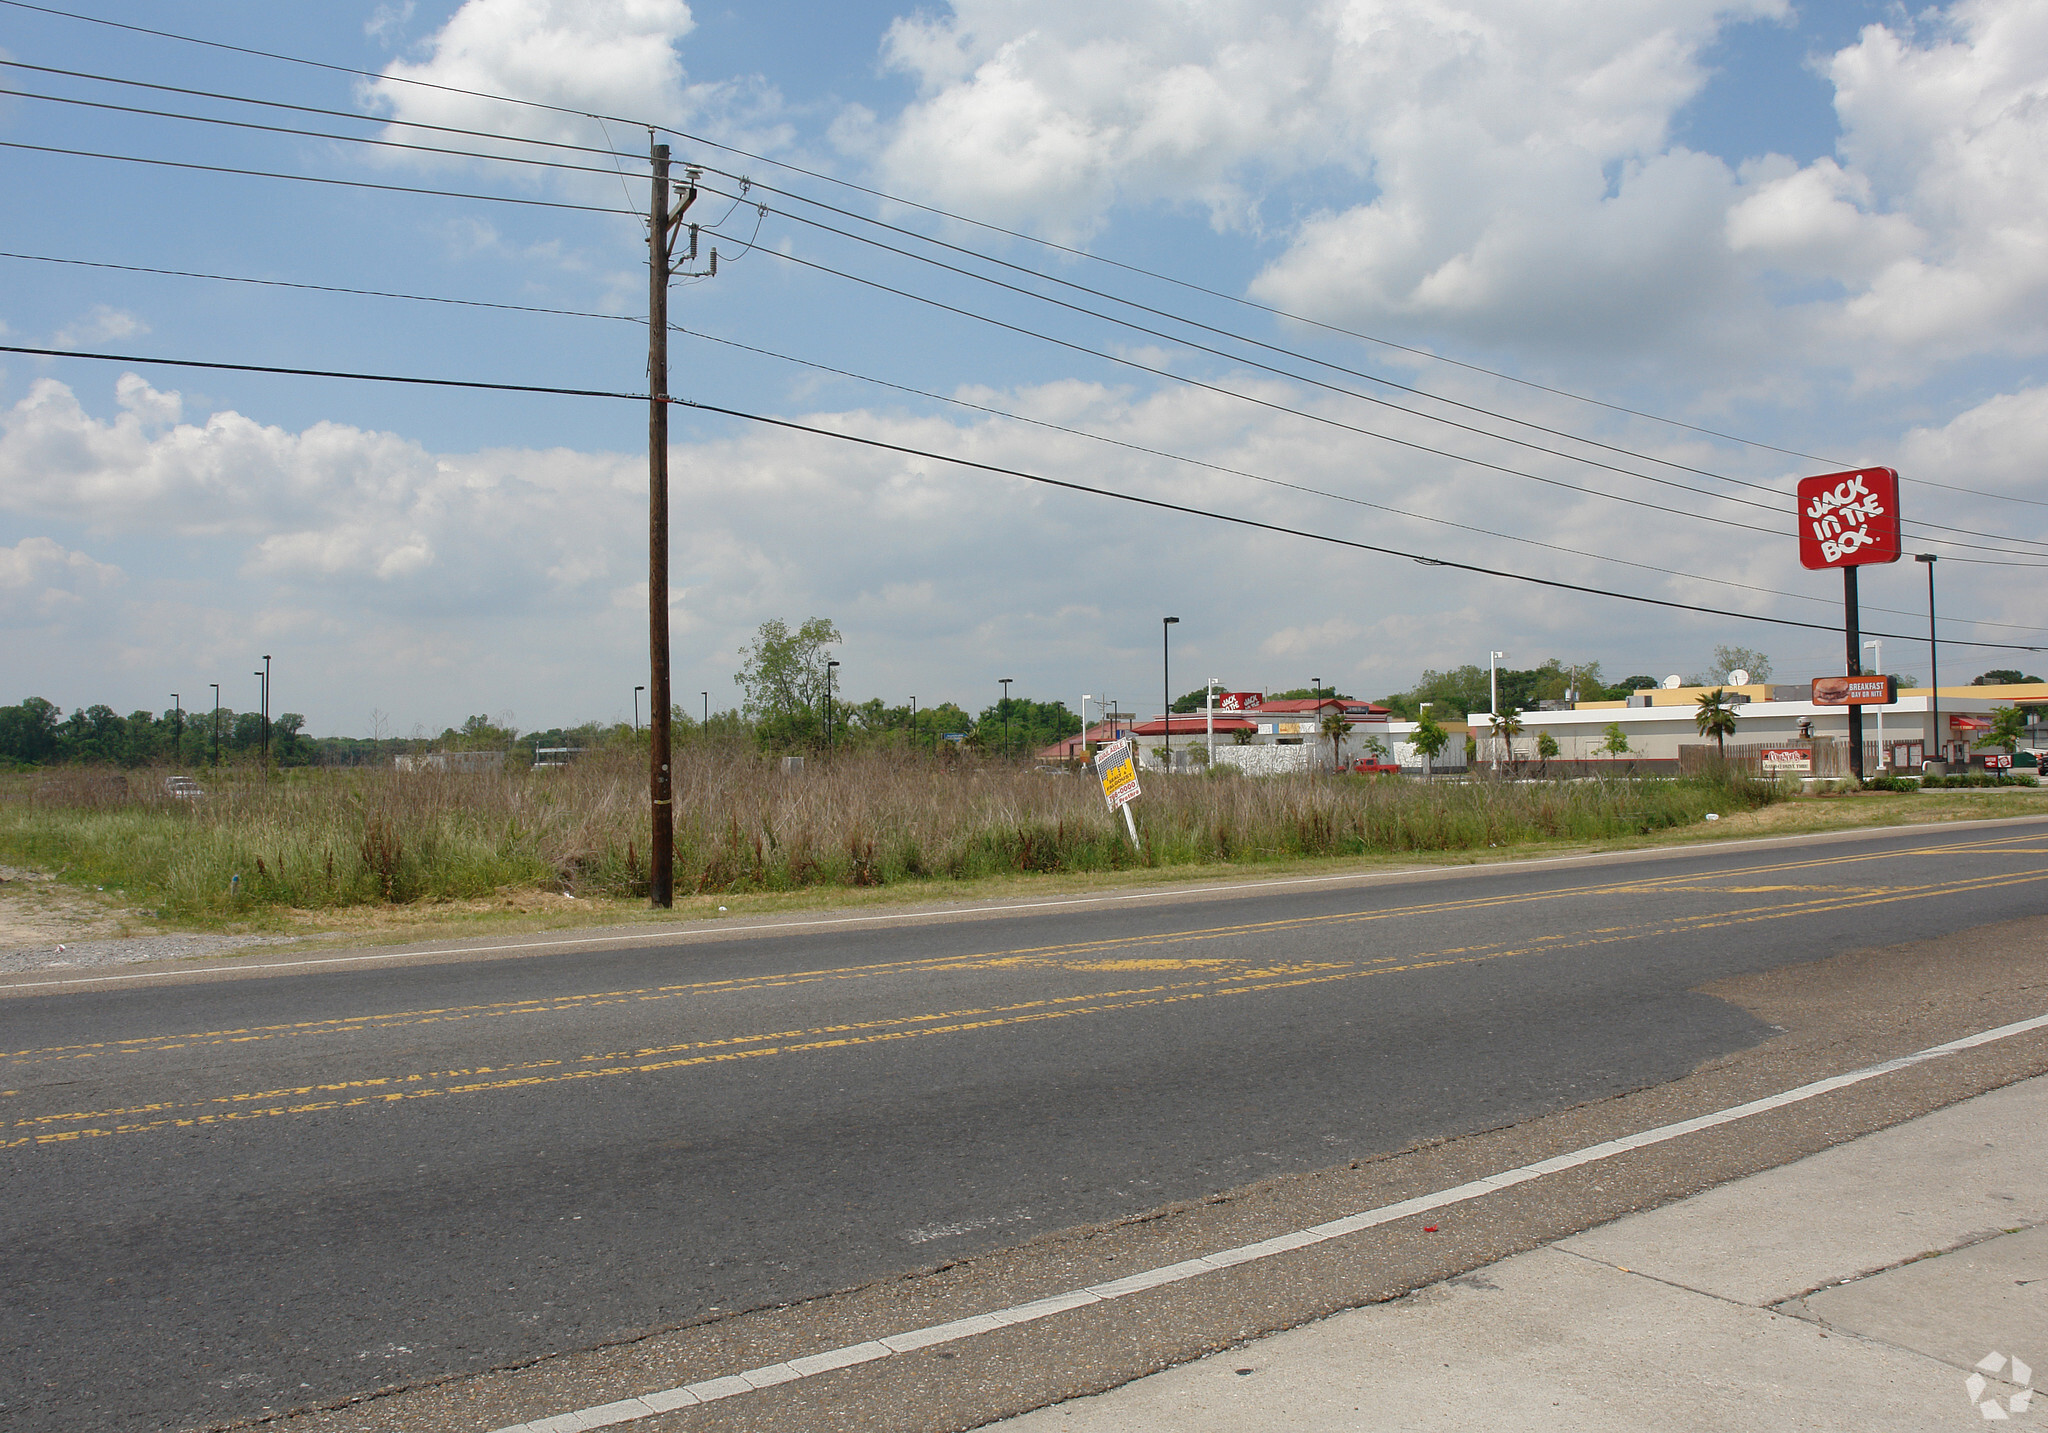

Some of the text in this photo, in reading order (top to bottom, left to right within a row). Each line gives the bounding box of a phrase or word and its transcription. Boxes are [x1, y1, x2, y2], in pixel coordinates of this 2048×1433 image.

[1807, 474, 1869, 518] JACK
[1839, 493, 1884, 526] THE
[1849, 682, 1884, 690] BREAKFAST
[1222, 694, 1236, 707] JACK
[1244, 695, 1257, 706] JACK
